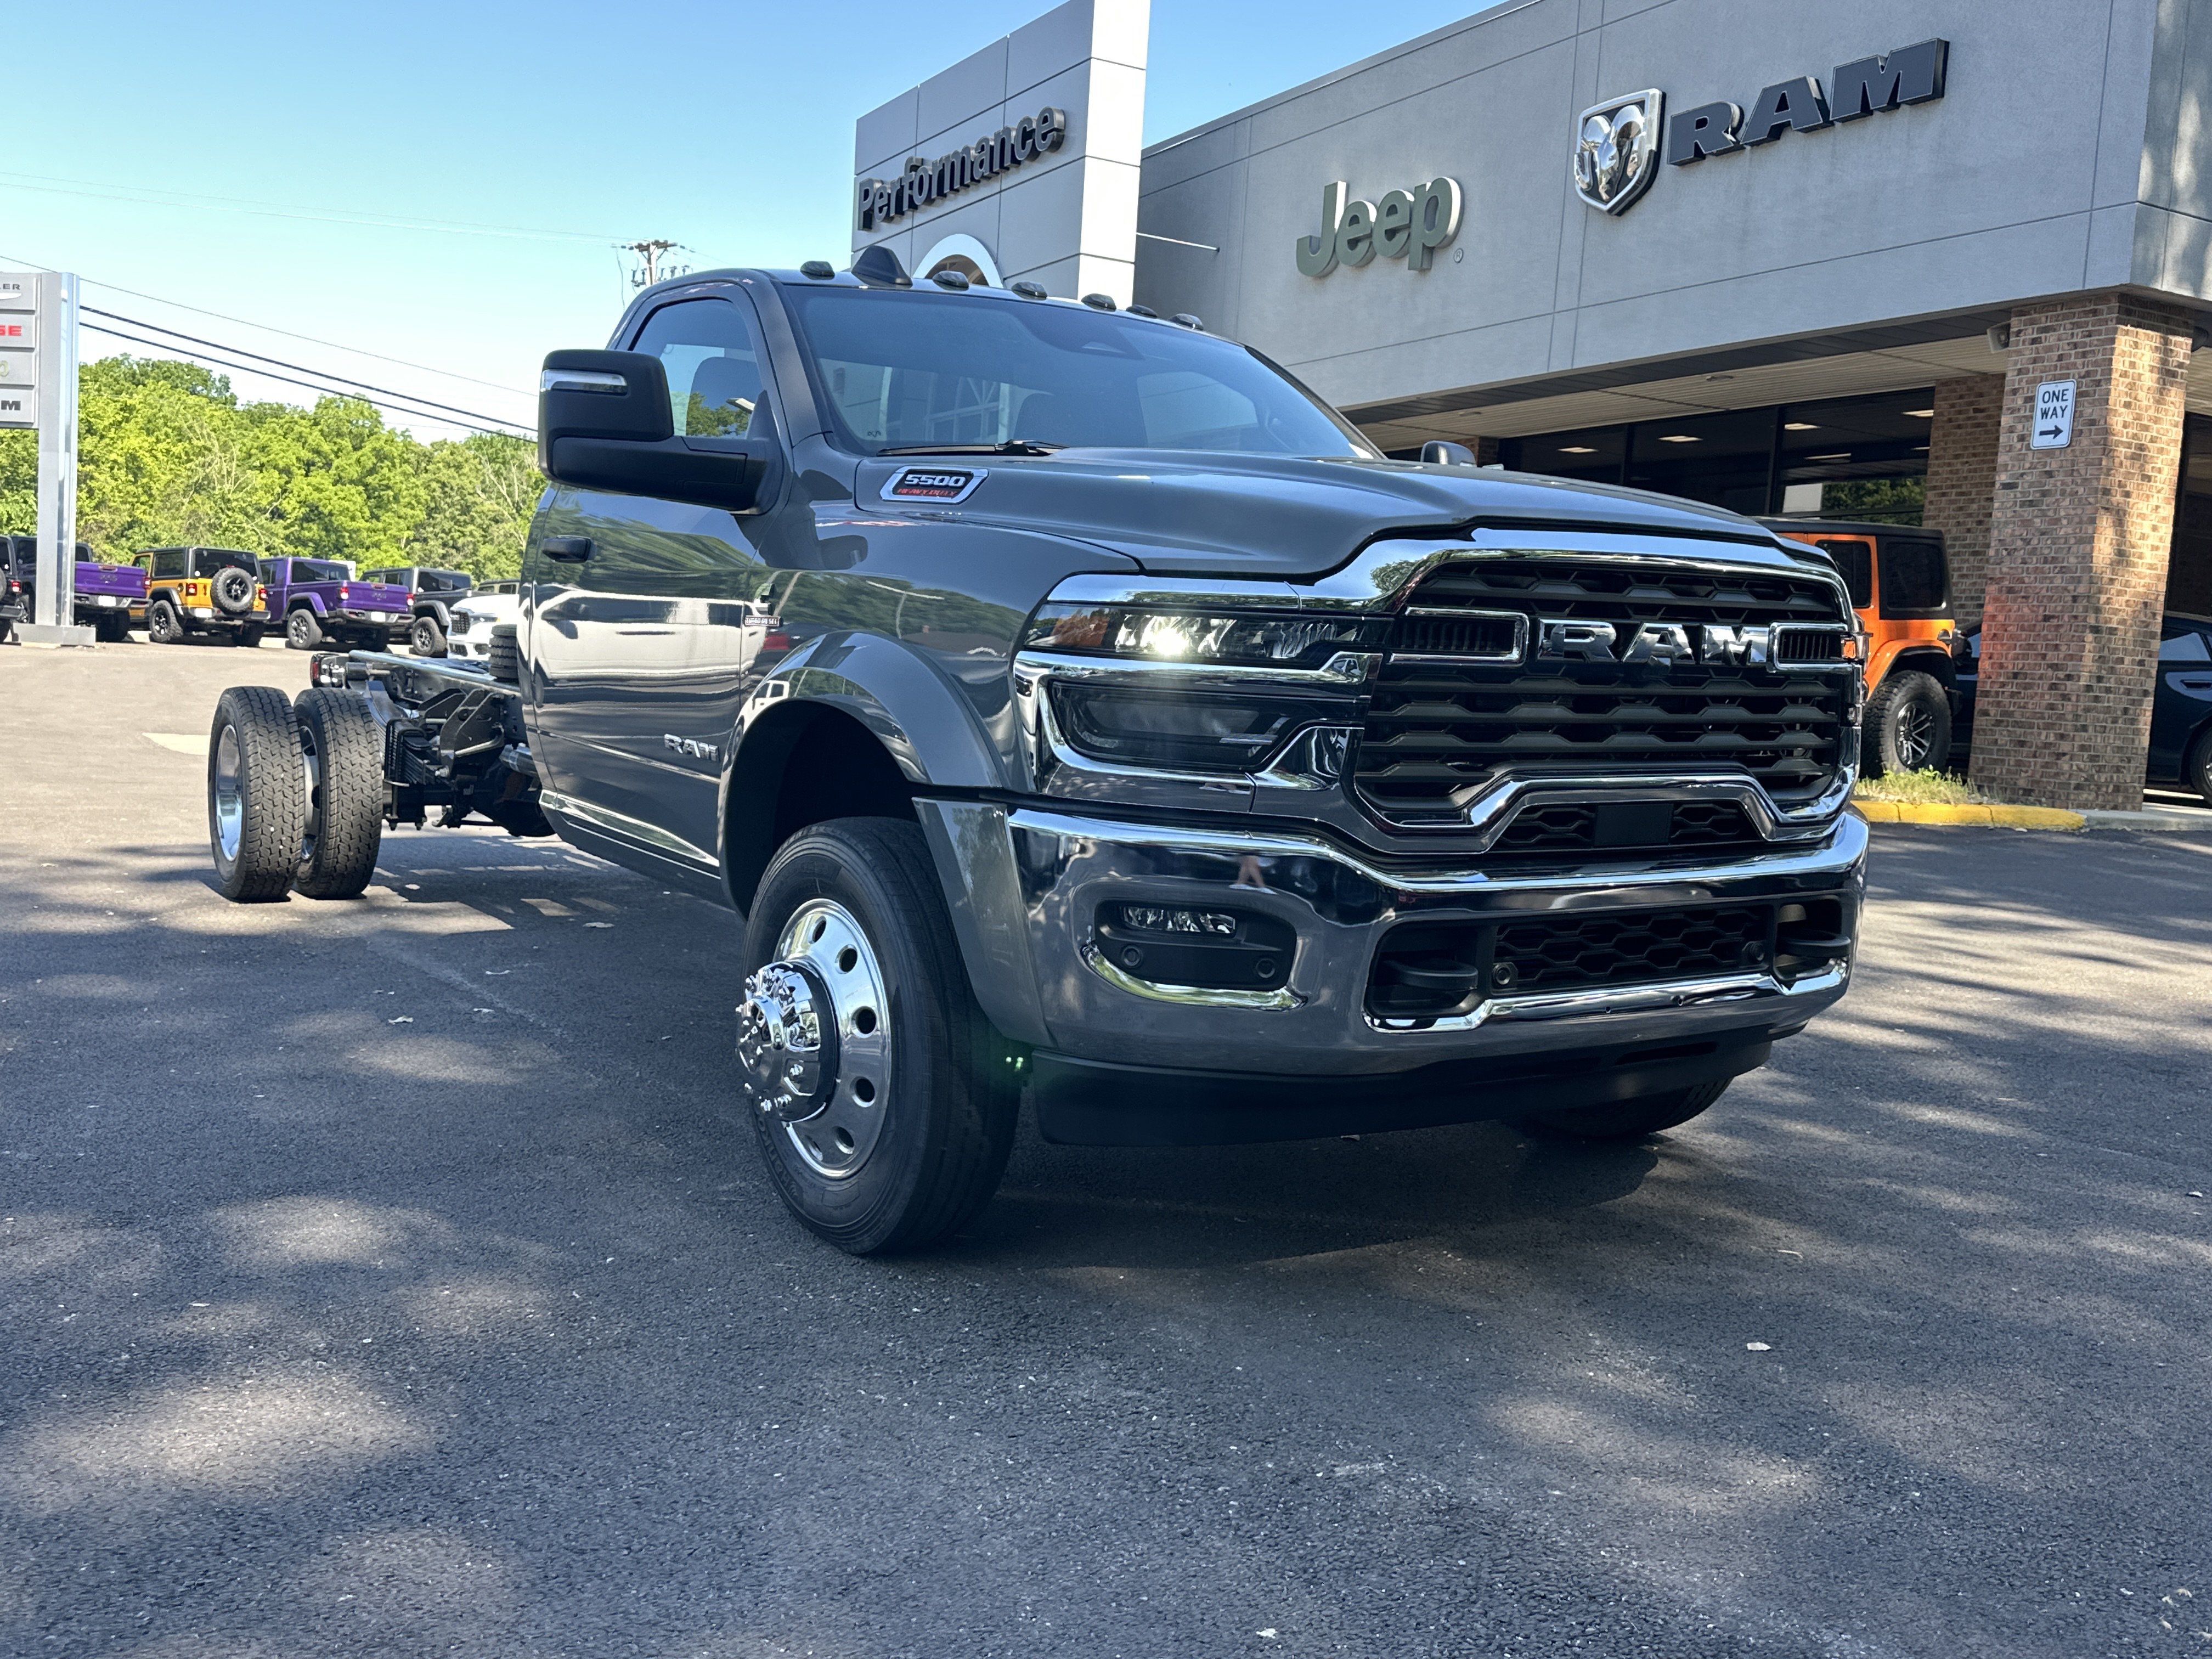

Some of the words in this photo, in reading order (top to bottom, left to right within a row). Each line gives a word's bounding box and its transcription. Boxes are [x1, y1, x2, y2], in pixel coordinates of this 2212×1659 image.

[1668, 38, 1950, 166] RAM
[858, 106, 1065, 230] Performance
[1296, 177, 1463, 278] Jeep
[2040, 405, 2068, 420] WAY
[2042, 388, 2069, 404] ONE
[905, 474, 966, 487] 5500
[1538, 618, 1769, 665] RAM
[664, 733, 720, 761] RAM
